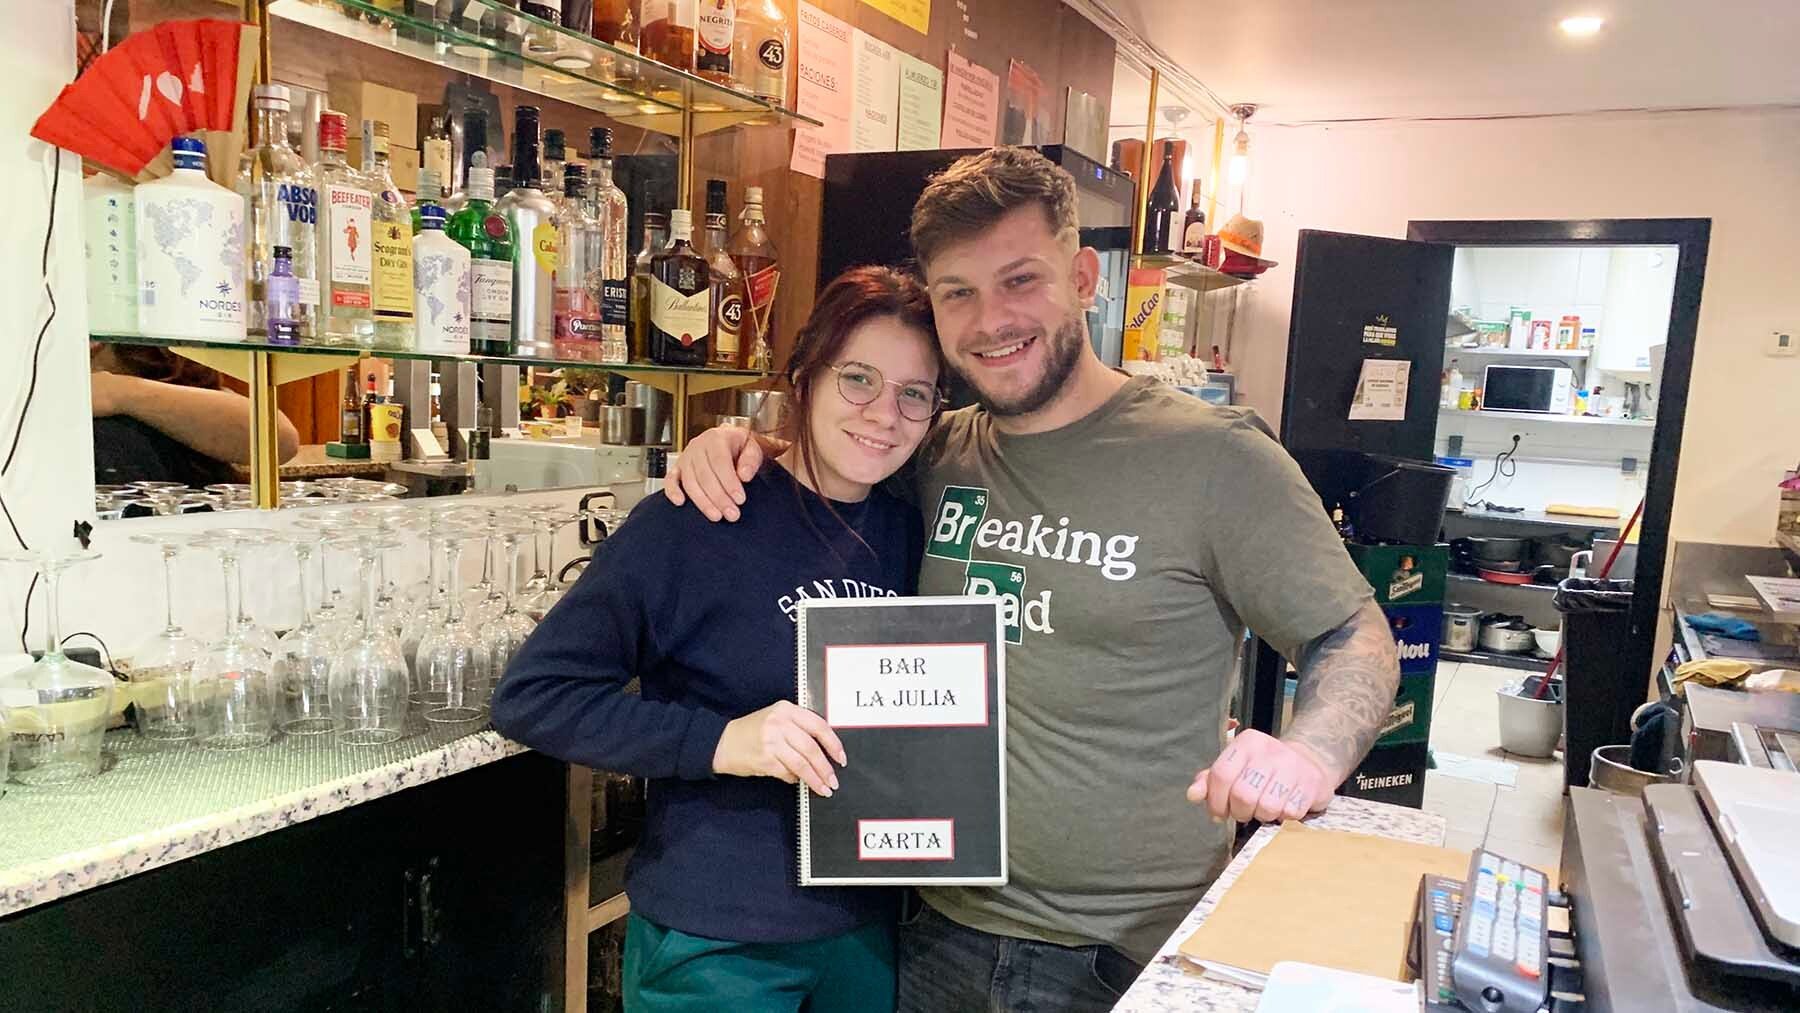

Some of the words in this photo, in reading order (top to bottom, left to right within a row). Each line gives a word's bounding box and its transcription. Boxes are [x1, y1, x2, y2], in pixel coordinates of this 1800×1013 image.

[762, 44, 783, 64] 43
[331, 190, 371, 209] BEEFEATER
[725, 304, 742, 321] 43
[934, 501, 1140, 581] Breaking
[1010, 571, 1023, 583] 56
[1395, 639, 1431, 660] hou
[879, 657, 927, 675] BAR
[855, 690, 884, 707] LA
[892, 688, 957, 706] JULIA
[1360, 773, 1413, 790] HEINEKEN
[863, 832, 942, 849] CARTA
